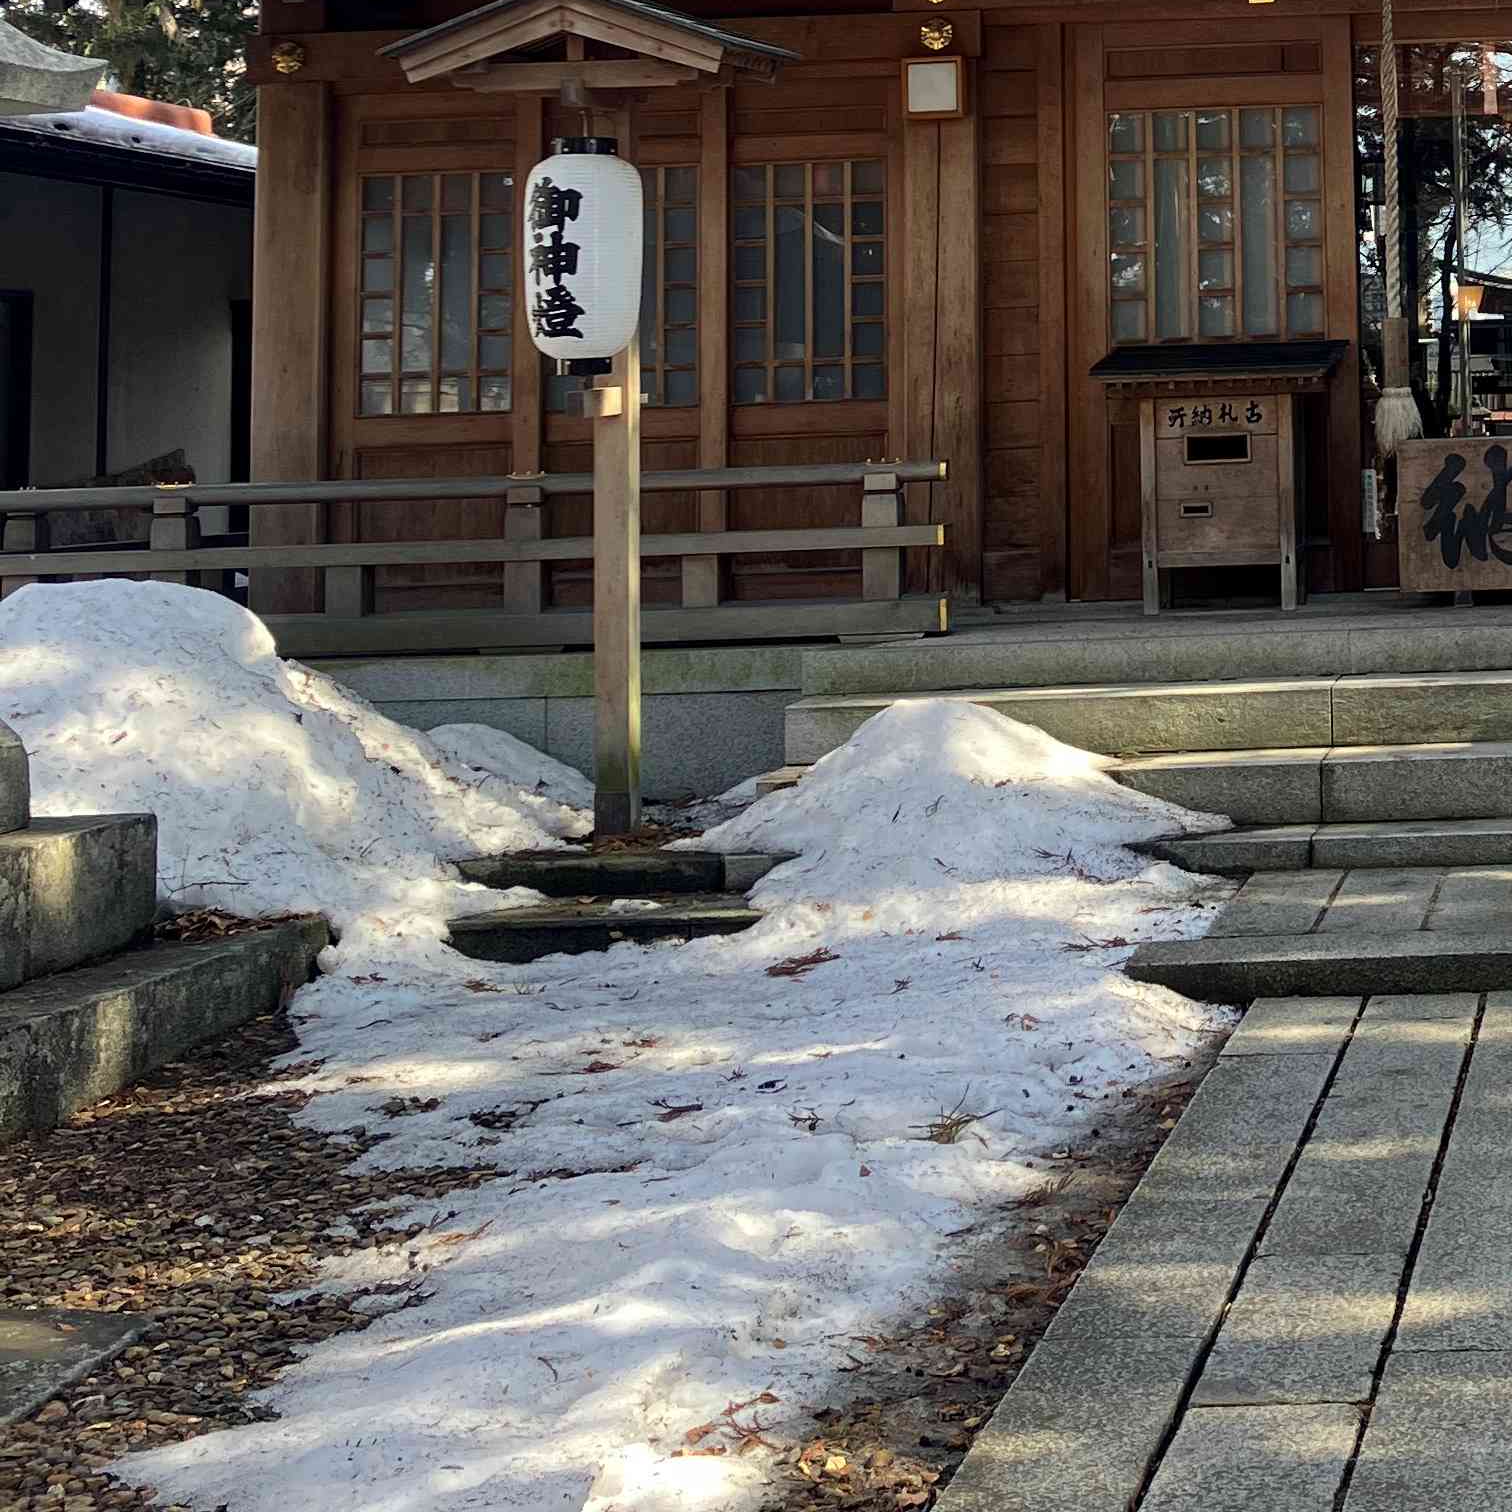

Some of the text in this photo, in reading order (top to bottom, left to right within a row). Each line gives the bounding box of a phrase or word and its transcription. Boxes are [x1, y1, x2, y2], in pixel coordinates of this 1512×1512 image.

[528, 176, 585, 338] 御神燈
[1168, 400, 1263, 427] 古札納所
